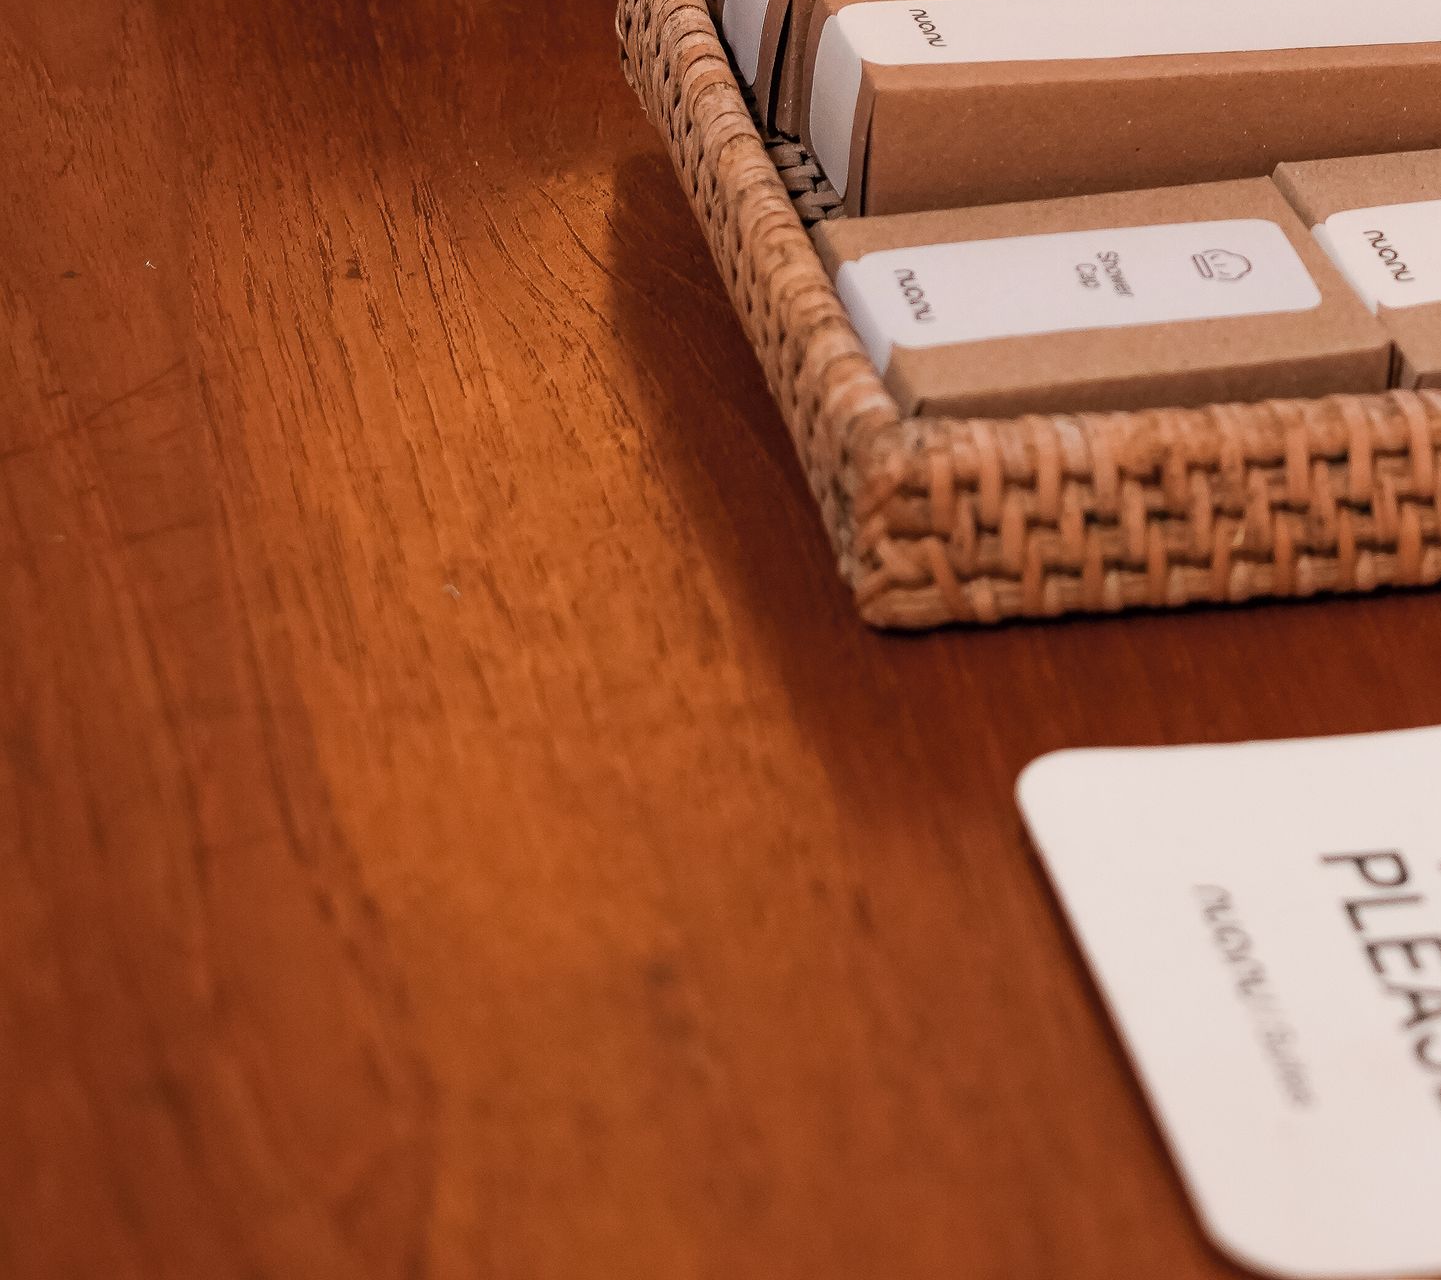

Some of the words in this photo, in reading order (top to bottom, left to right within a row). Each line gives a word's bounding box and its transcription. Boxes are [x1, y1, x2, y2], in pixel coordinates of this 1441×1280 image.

[909, 8, 947, 47] nuanu
[1076, 263, 1101, 289] Cap
[1096, 250, 1135, 297] Shower
[1362, 229, 1415, 282] nuanu
